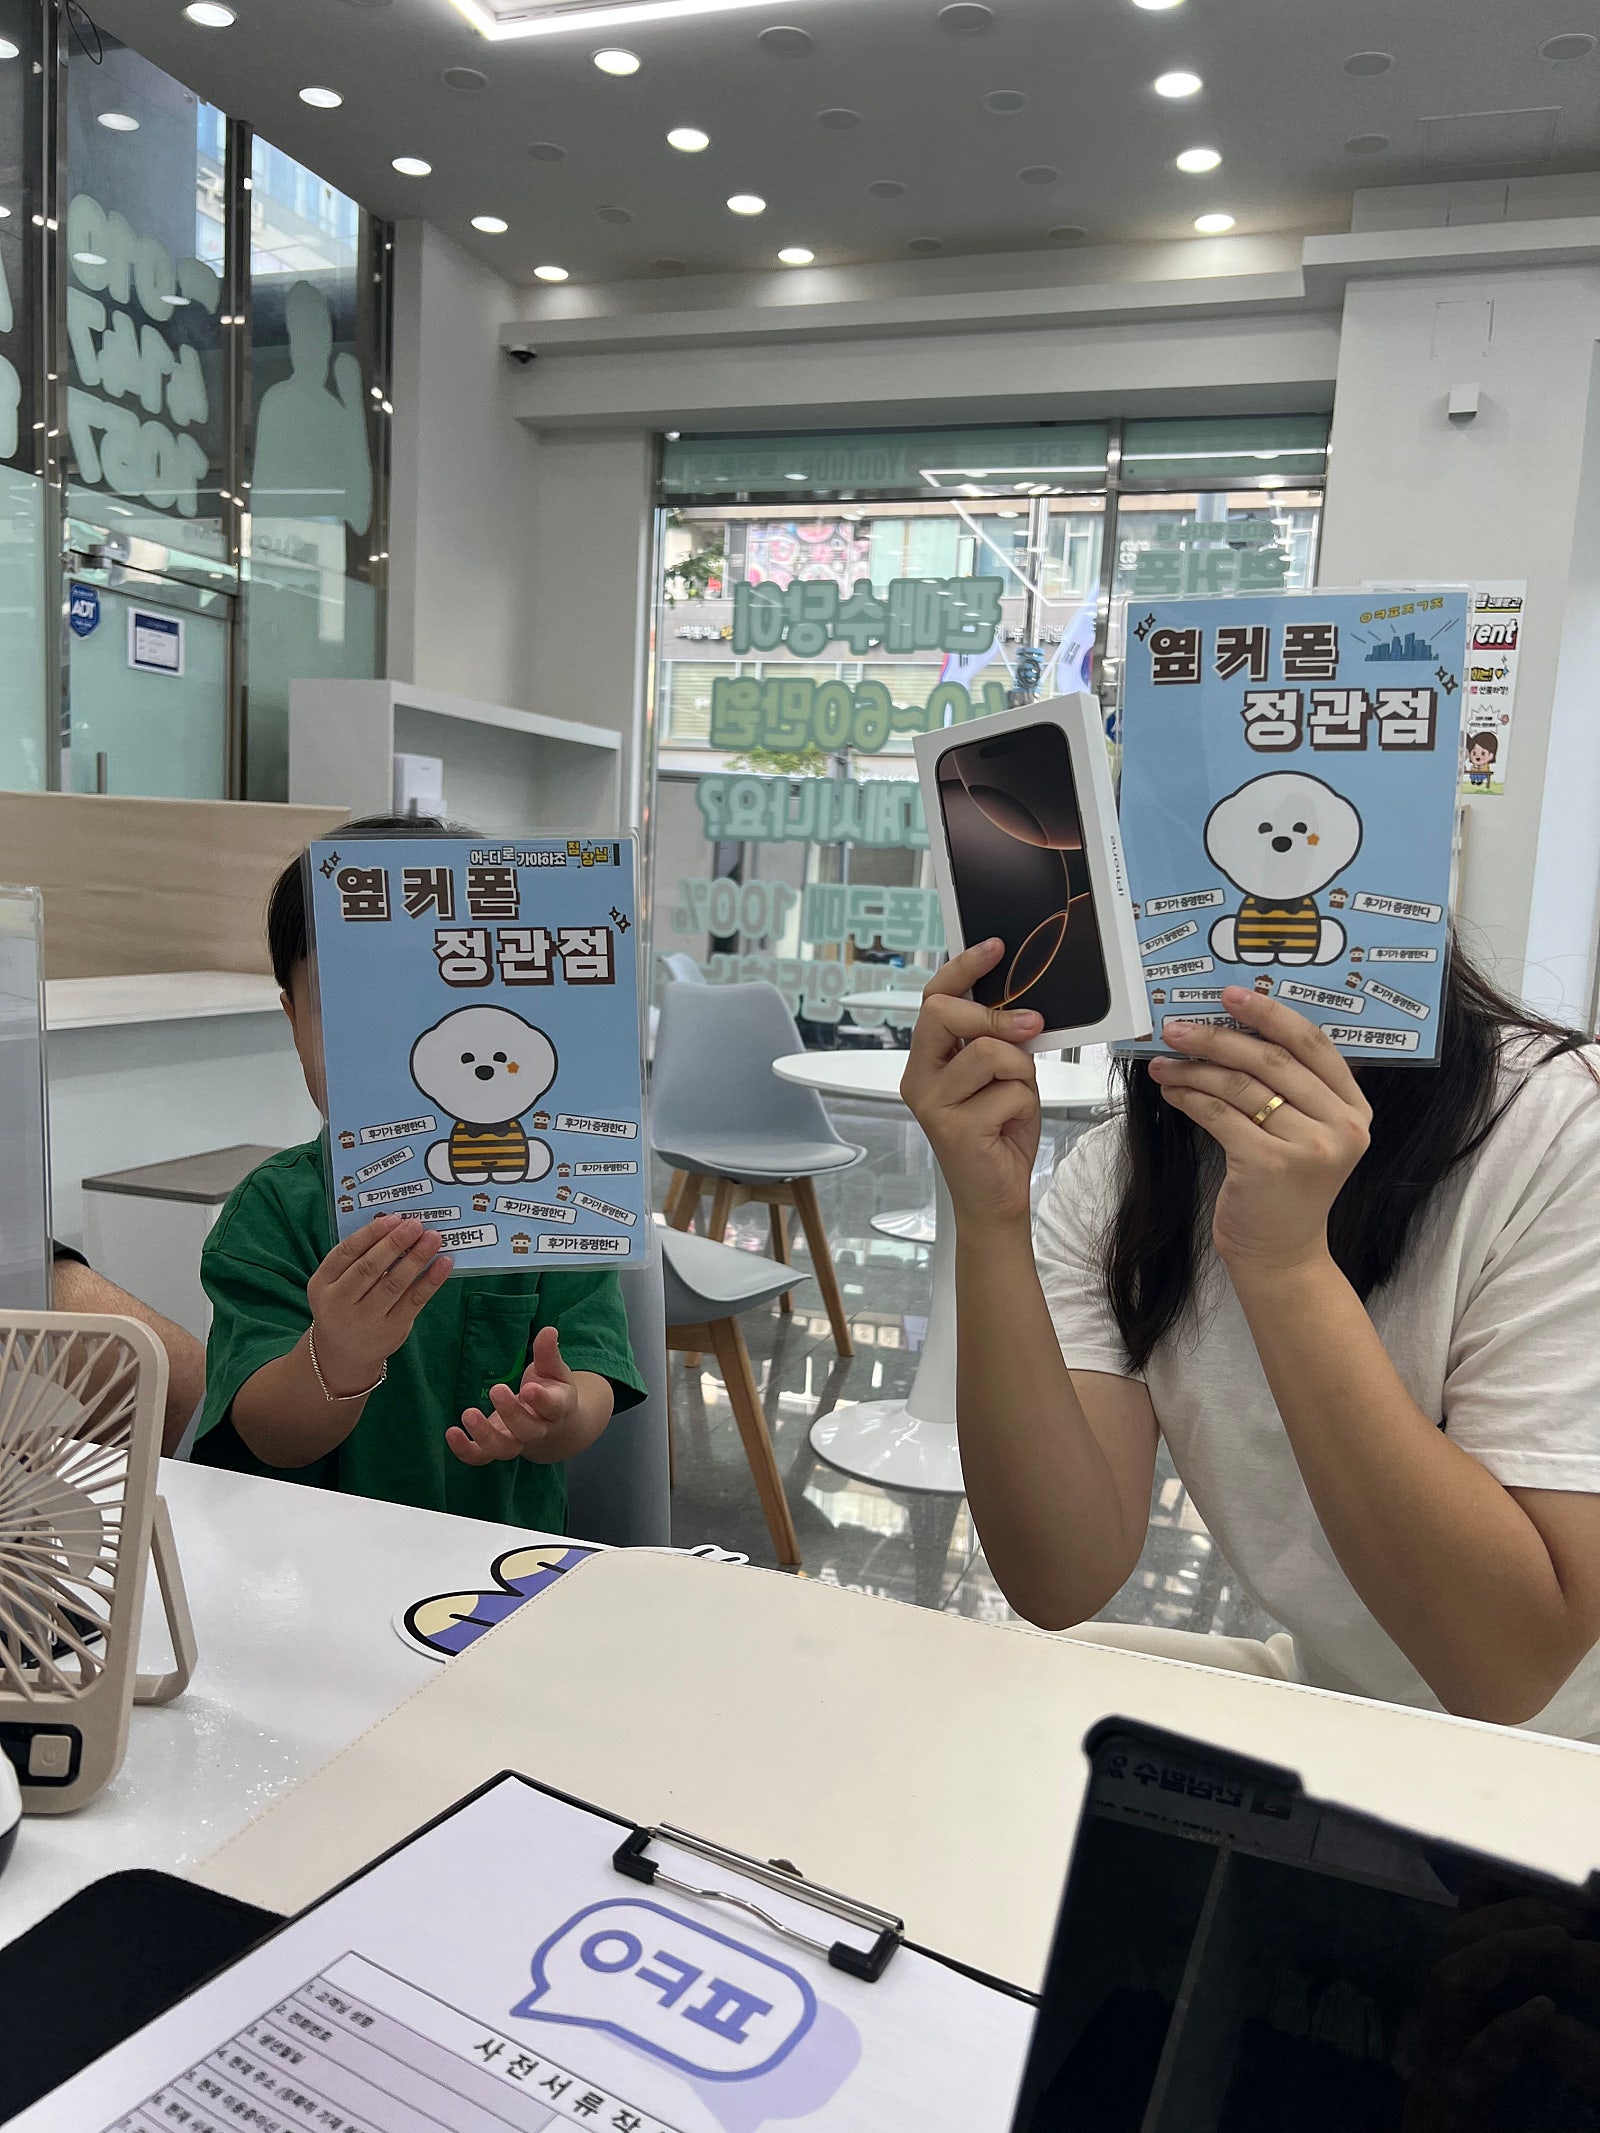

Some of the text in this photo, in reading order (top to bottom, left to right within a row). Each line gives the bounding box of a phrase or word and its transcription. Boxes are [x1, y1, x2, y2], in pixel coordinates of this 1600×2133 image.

[71, 600, 97, 619] ADT
[1471, 618, 1519, 646] ent
[1149, 623, 1339, 685] 옆커폰
[1240, 687, 1439, 753] 정관점
[336, 866, 520, 922] 옆커폰
[1154, 892, 1214, 912] 후기가 증명한다
[1362, 896, 1430, 918] 후기가 증명한다
[432, 926, 616, 988] 정관점
[1376, 950, 1398, 959] 후기가
[1146, 960, 1204, 978] 후기가 증명한다
[1177, 989, 1222, 1000] 후기가 증명한
[1287, 984, 1353, 1009] 후기가 증명한다
[1370, 984, 1422, 1013] 후기가 증명한다
[1329, 1027, 1407, 1045] 후기가 증명한다
[368, 1120, 427, 1140] 후기가 증명한다
[564, 1118, 627, 1135] 후기가 증명한다
[362, 1162, 382, 1177] 후기가
[581, 1163, 601, 1172] 후기가
[366, 1183, 423, 1203] 후기가 증명한다
[423, 1209, 452, 1220] 증명한다
[504, 1200, 566, 1220] 후기가 증명한다
[579, 1196, 629, 1220] 후기가 증명한다
[547, 1237, 619, 1251] 후기가 증명한다
